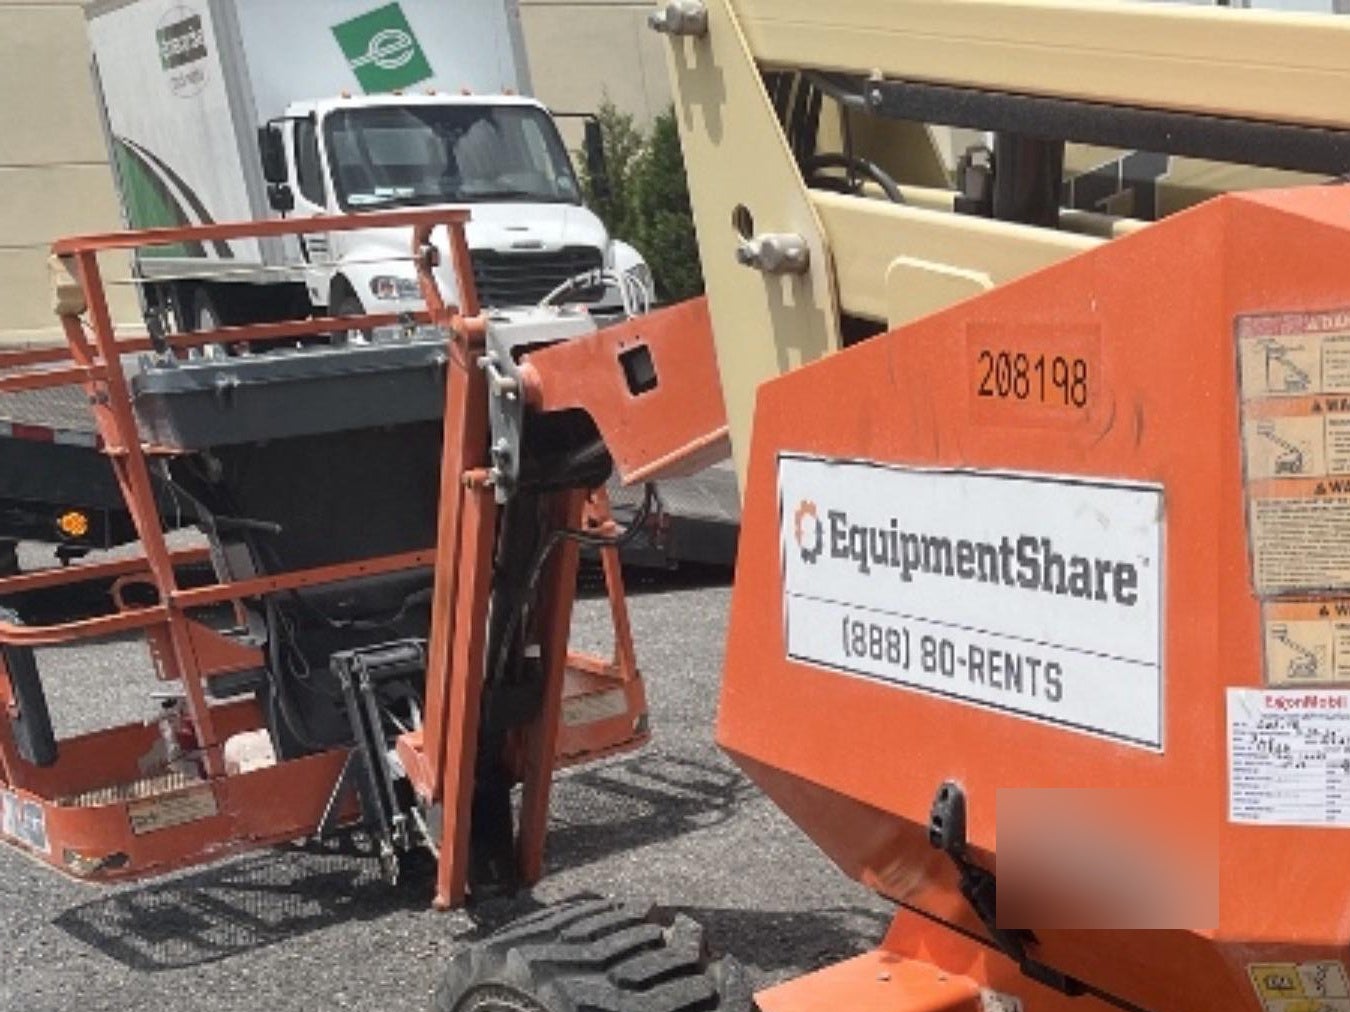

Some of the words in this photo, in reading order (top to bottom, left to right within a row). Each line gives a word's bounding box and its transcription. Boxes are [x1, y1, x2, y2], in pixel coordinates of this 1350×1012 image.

[977, 349, 1089, 408] 208198
[827, 510, 1139, 607] EquipmentShare
[842, 616, 911, 670] (888)
[920, 635, 1064, 703] 80-RENTS
